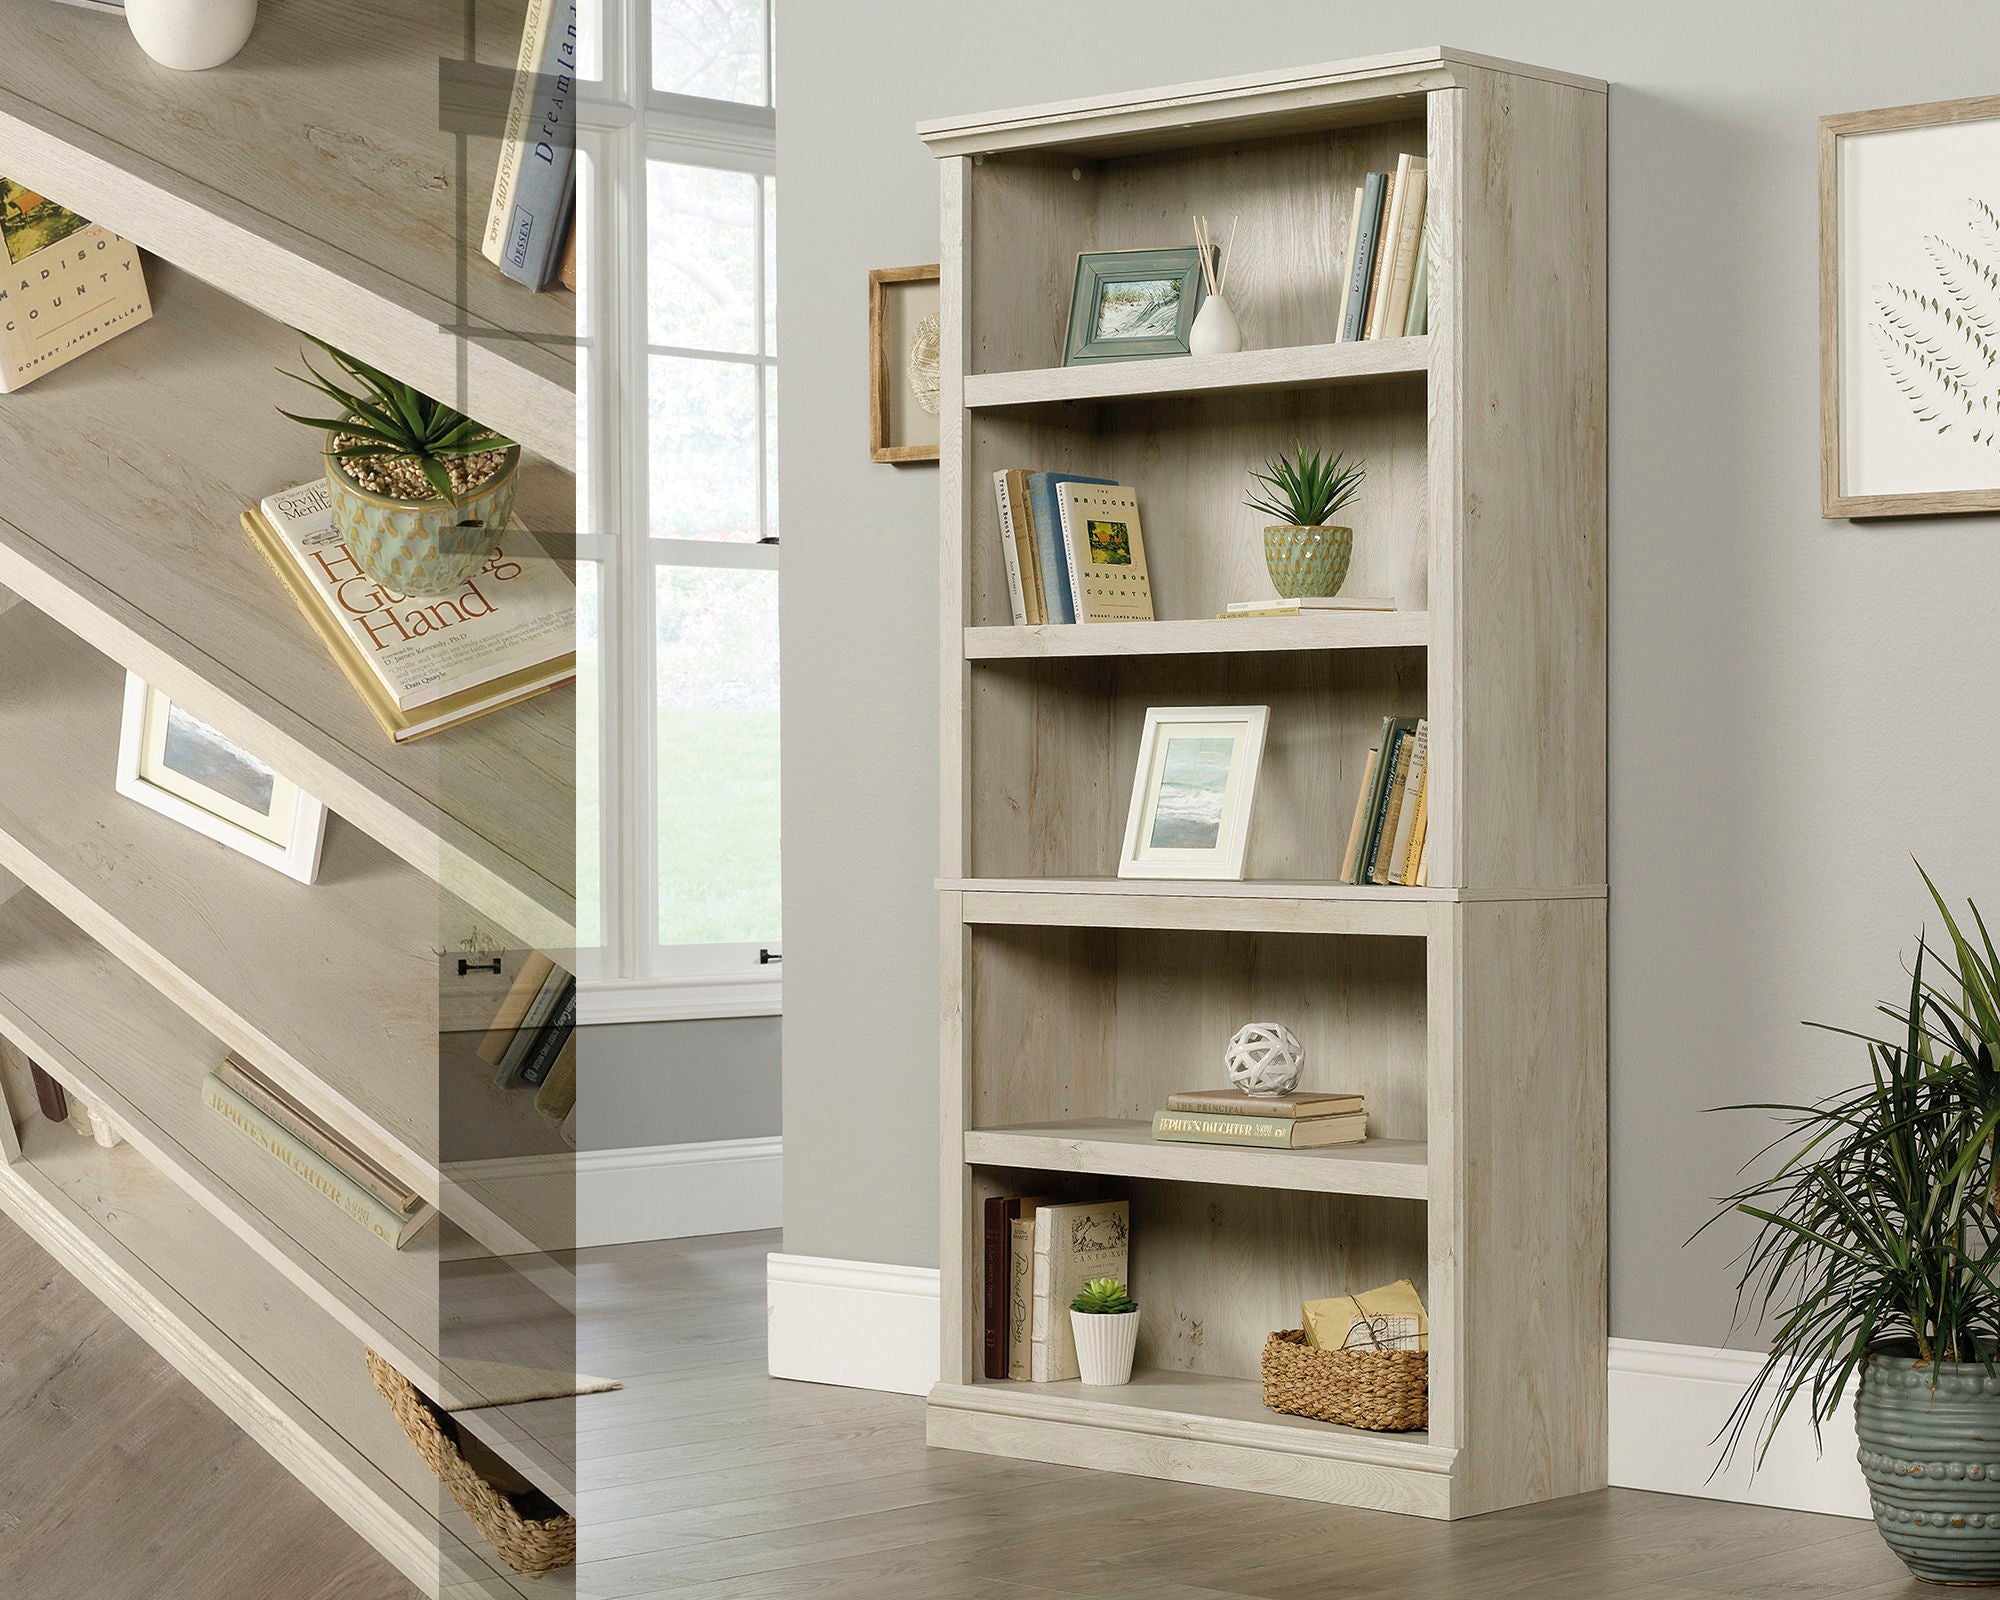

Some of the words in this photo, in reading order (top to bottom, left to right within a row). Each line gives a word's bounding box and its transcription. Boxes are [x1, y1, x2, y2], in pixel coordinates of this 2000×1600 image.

[519, 30, 536, 88] STORIES
[515, 87, 525, 108] OF
[500, 107, 521, 178] CHRISTMAS
[496, 175, 509, 211] LOVE
[513, 219, 530, 266] DESSEN
[6, 260, 132, 331] COUNTY
[18, 347, 60, 373] ROBERT
[65, 326, 99, 348] JAMES
[103, 303, 142, 328] WALLER
[278, 489, 329, 511] Orville
[1073, 497, 1135, 507] BRIDGES
[1084, 572, 1145, 581] MADISON
[1086, 588, 1148, 598] COUNTY
[353, 579, 499, 652] Hand
[421, 671, 447, 684] Quayle
[1176, 1102, 1192, 1111] THE
[1196, 1103, 1245, 1114] PRINCIPAL
[1202, 1120, 1253, 1137] DAUGHTER
[270, 1138, 342, 1203] DAUGHTER
[1011, 1298, 1027, 1348] Daisy
